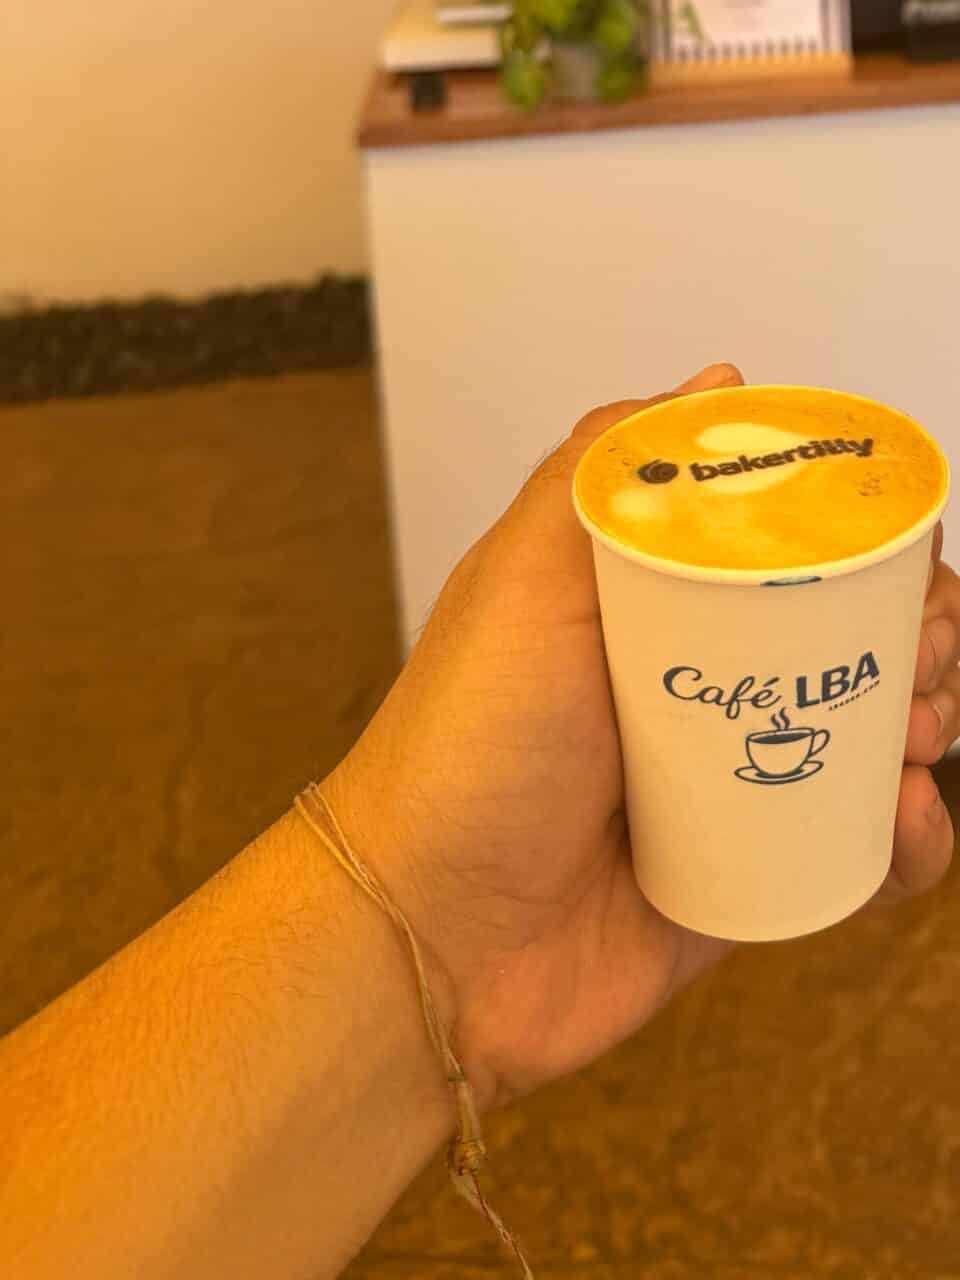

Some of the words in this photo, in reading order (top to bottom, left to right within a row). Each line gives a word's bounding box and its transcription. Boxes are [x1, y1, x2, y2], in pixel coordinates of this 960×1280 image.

[690, 438, 874, 482] bakertilly
[662, 665, 783, 721] Café
[795, 650, 881, 710] LBA
